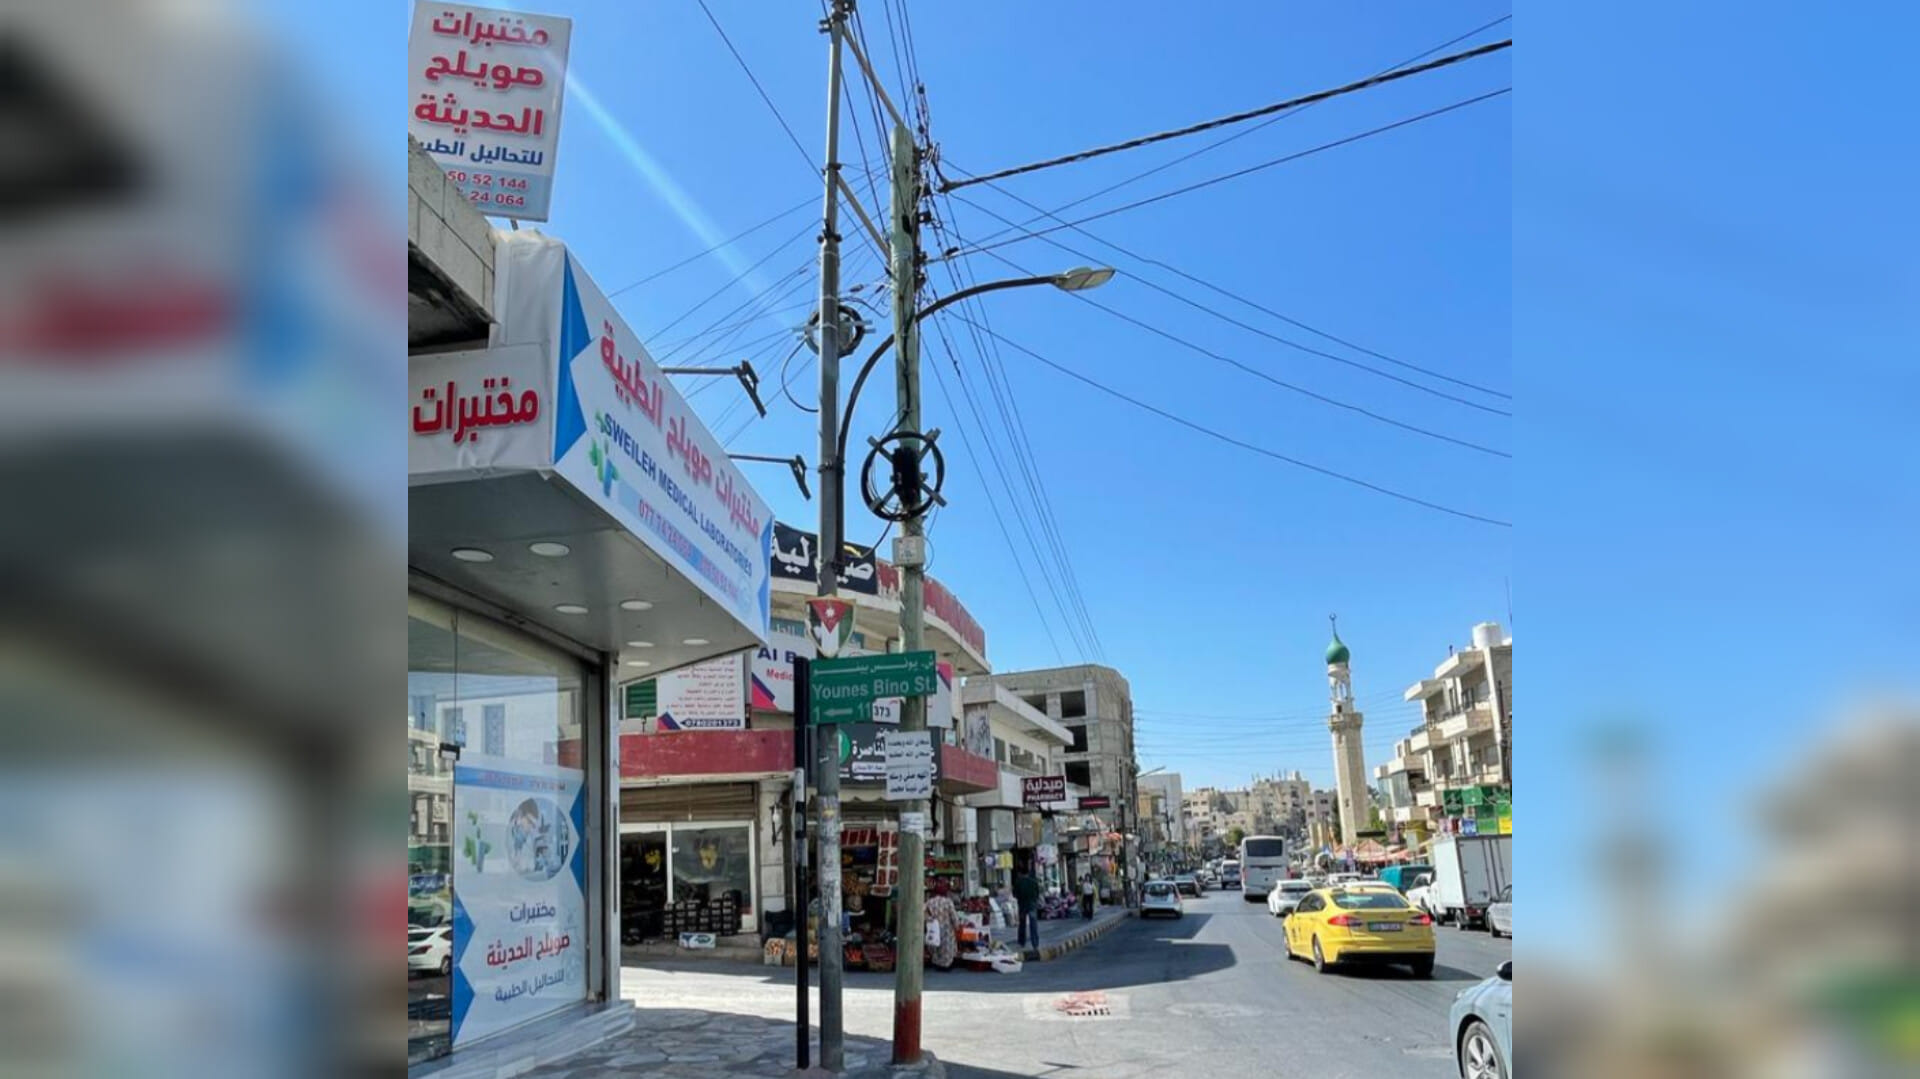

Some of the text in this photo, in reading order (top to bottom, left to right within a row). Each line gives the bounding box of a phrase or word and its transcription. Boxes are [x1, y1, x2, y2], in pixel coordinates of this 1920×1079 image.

[432, 12, 549, 46] مختبرات
[425, 51, 544, 89] صويلح
[415, 93, 544, 136] الحديثة
[470, 144, 543, 166] للتحاليل
[470, 191, 525, 206] 24 064
[473, 174, 492, 186] 52
[499, 178, 526, 189] 144
[601, 319, 663, 430] الطبية
[413, 377, 539, 443] مختبرات
[667, 416, 713, 486] صويلح
[605, 413, 657, 481] SWEILEH
[659, 468, 699, 525] MEDICAL
[700, 512, 753, 577] LABORATORIES
[715, 468, 760, 541] مختبرات
[812, 675, 936, 700] Younes Bino St.
[1026, 778, 1064, 793] صيدلية
[1026, 793, 1064, 801] PHARMACY
[510, 901, 556, 924] مختبرات
[486, 931, 570, 970] صويلح الحديثة
[495, 979, 528, 1003] الطبية
